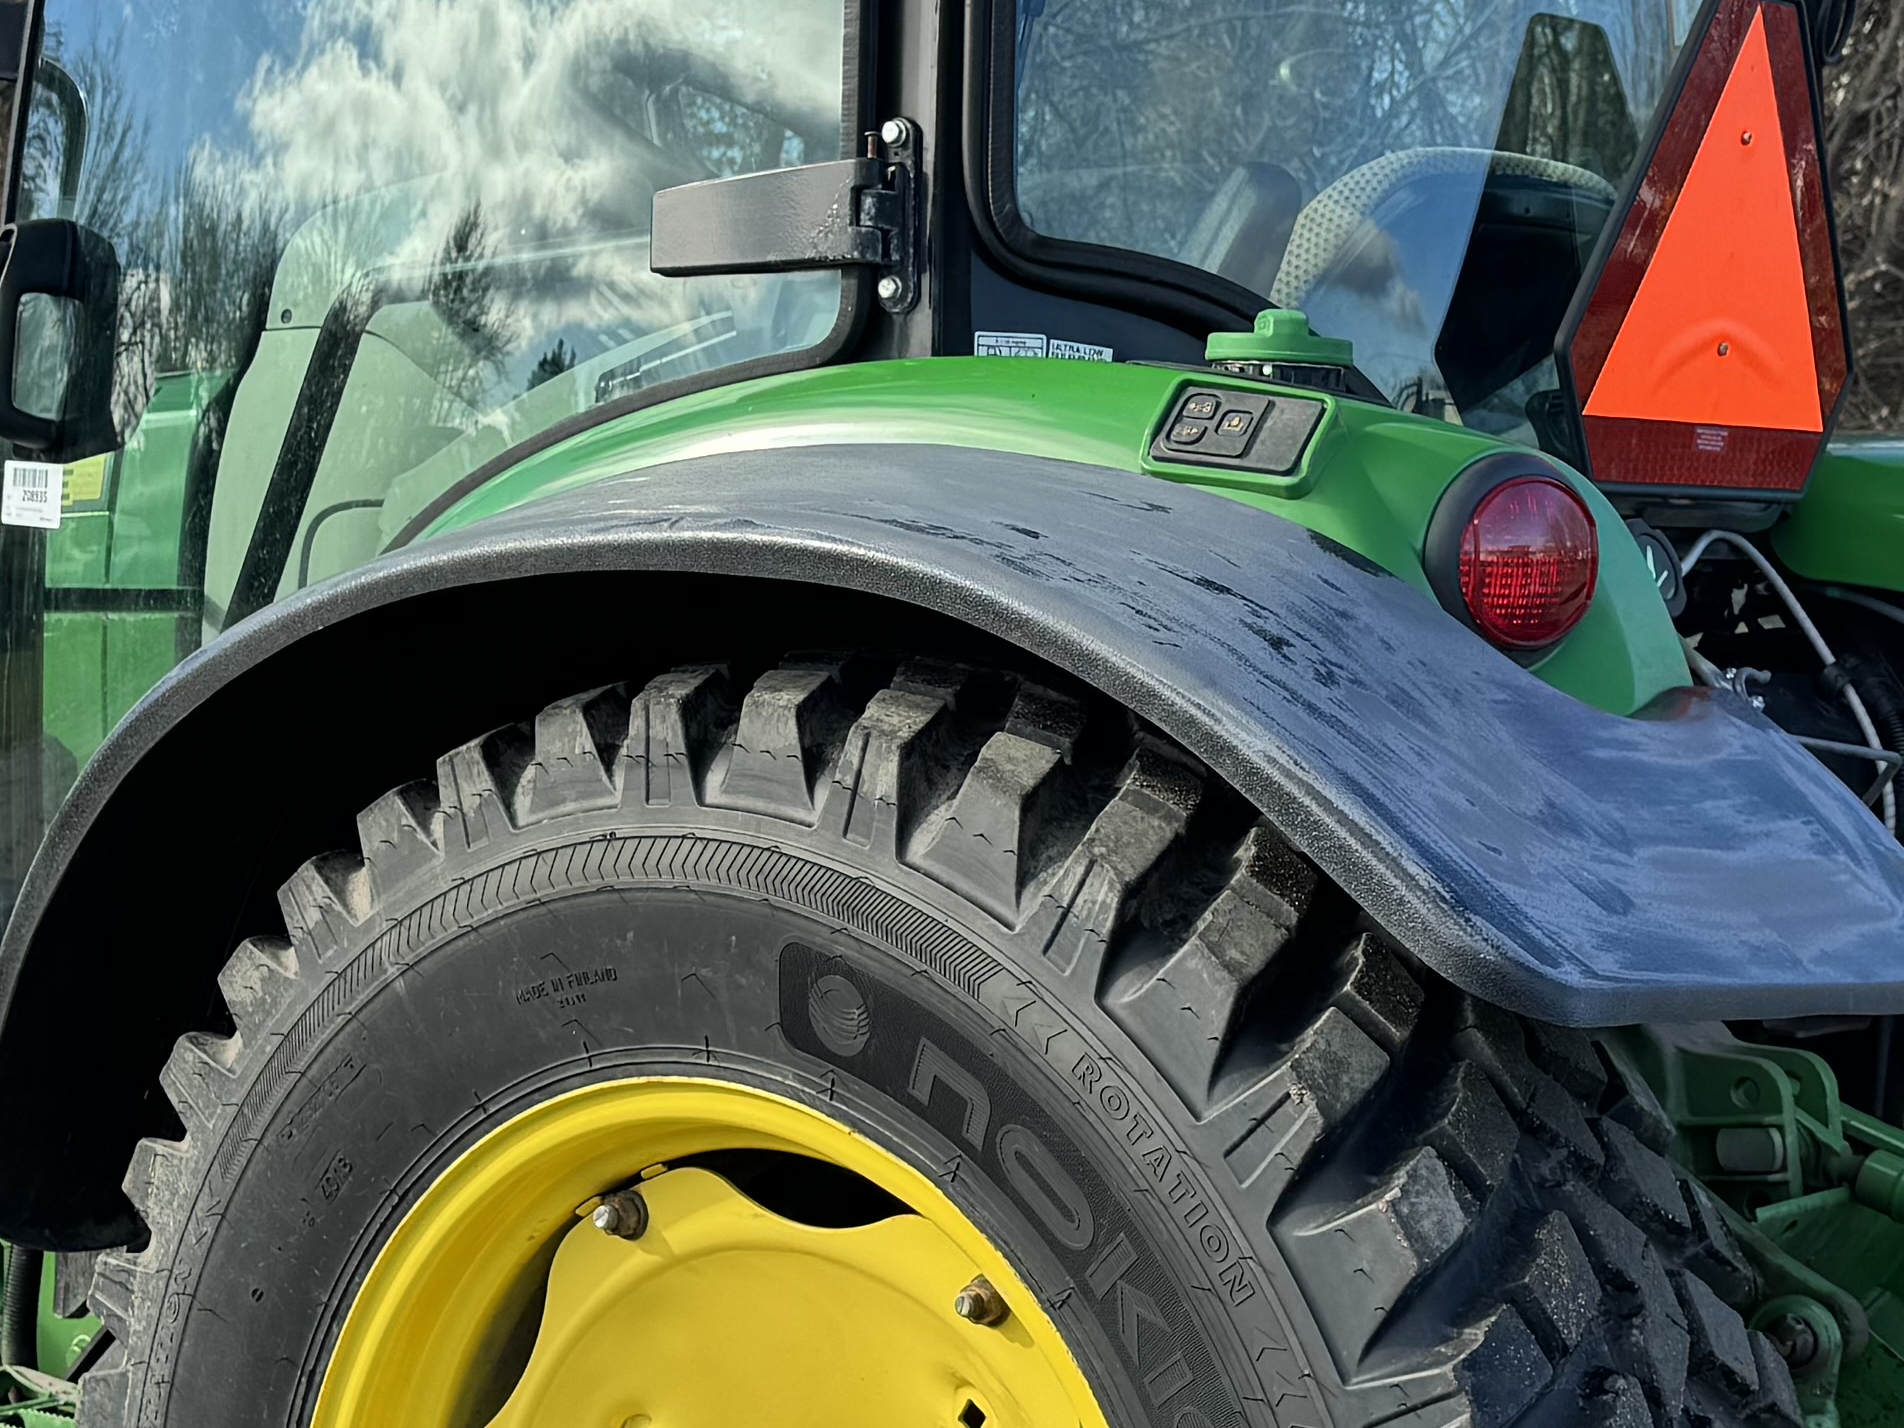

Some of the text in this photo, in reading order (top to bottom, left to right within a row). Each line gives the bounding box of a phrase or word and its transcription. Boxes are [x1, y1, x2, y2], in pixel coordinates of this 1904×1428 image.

[516, 981, 549, 1004] MADE
[551, 976, 564, 993] IN
[1072, 1051, 1256, 1309] ROTATION
